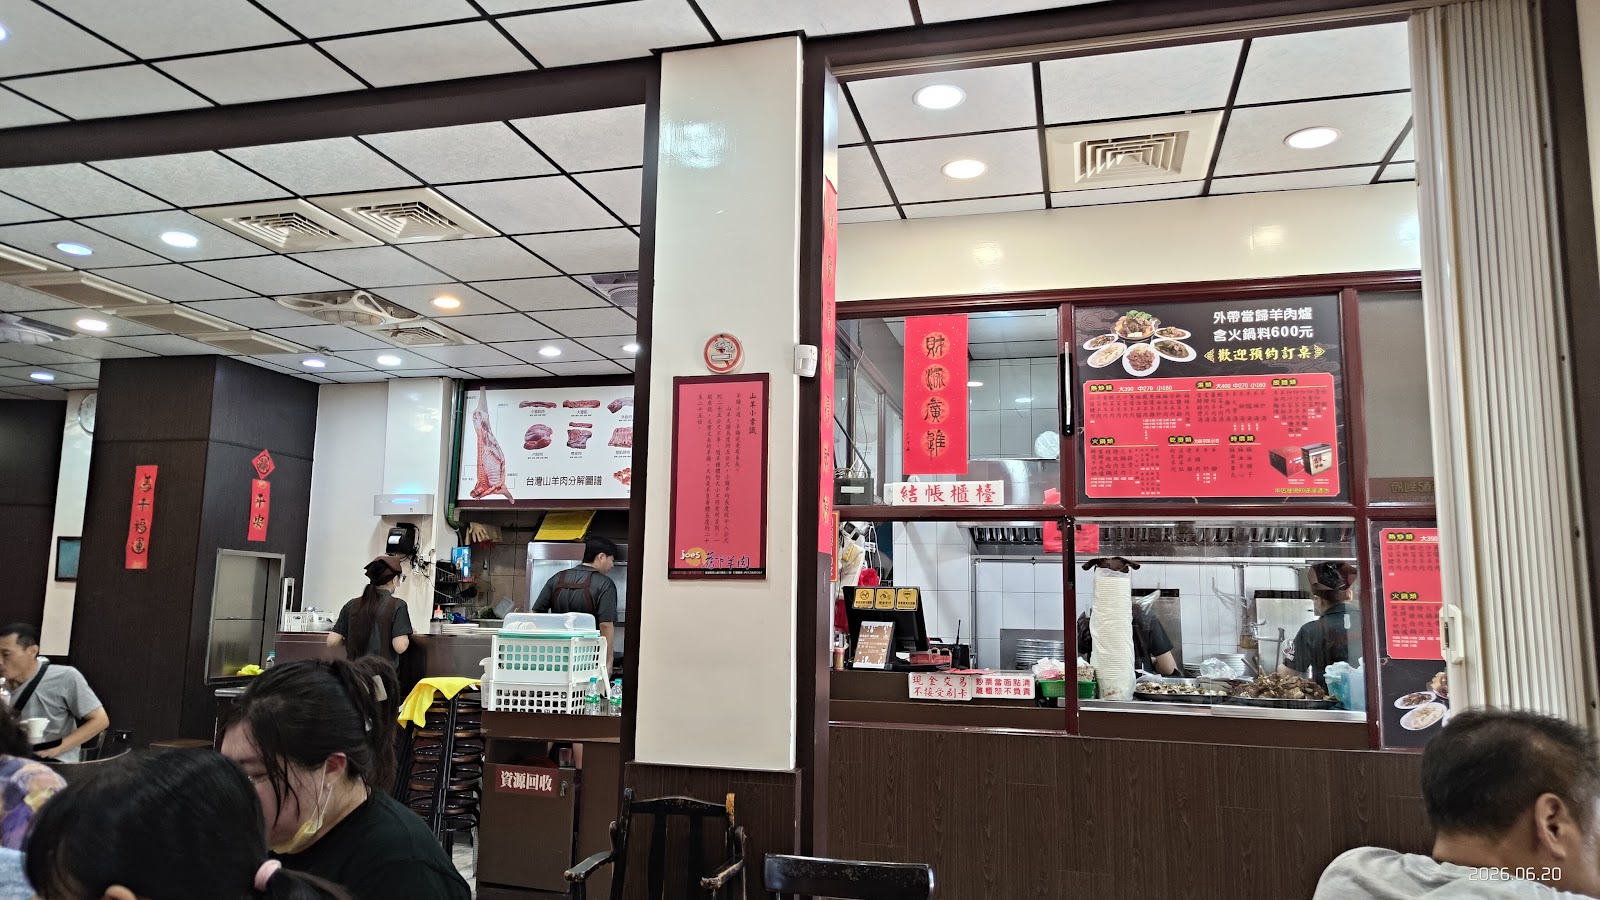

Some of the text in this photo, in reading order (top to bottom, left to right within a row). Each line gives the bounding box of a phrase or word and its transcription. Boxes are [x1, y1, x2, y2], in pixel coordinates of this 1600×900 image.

[1213, 307, 1313, 324] 外帶當歸羊肉爐
[1213, 326, 1314, 342] 含火鍋料600元
[1218, 346, 1312, 362] 歡迎預約訂桌
[526, 476, 602, 486] 台灣山羊肉分解圖譜
[900, 484, 996, 504] 結帳櫃檯
[912, 676, 968, 687] 現金交易
[976, 678, 1031, 686] 鈔票當面點清
[914, 687, 968, 699] 不接受刷卡
[500, 770, 553, 792] 資源回收
